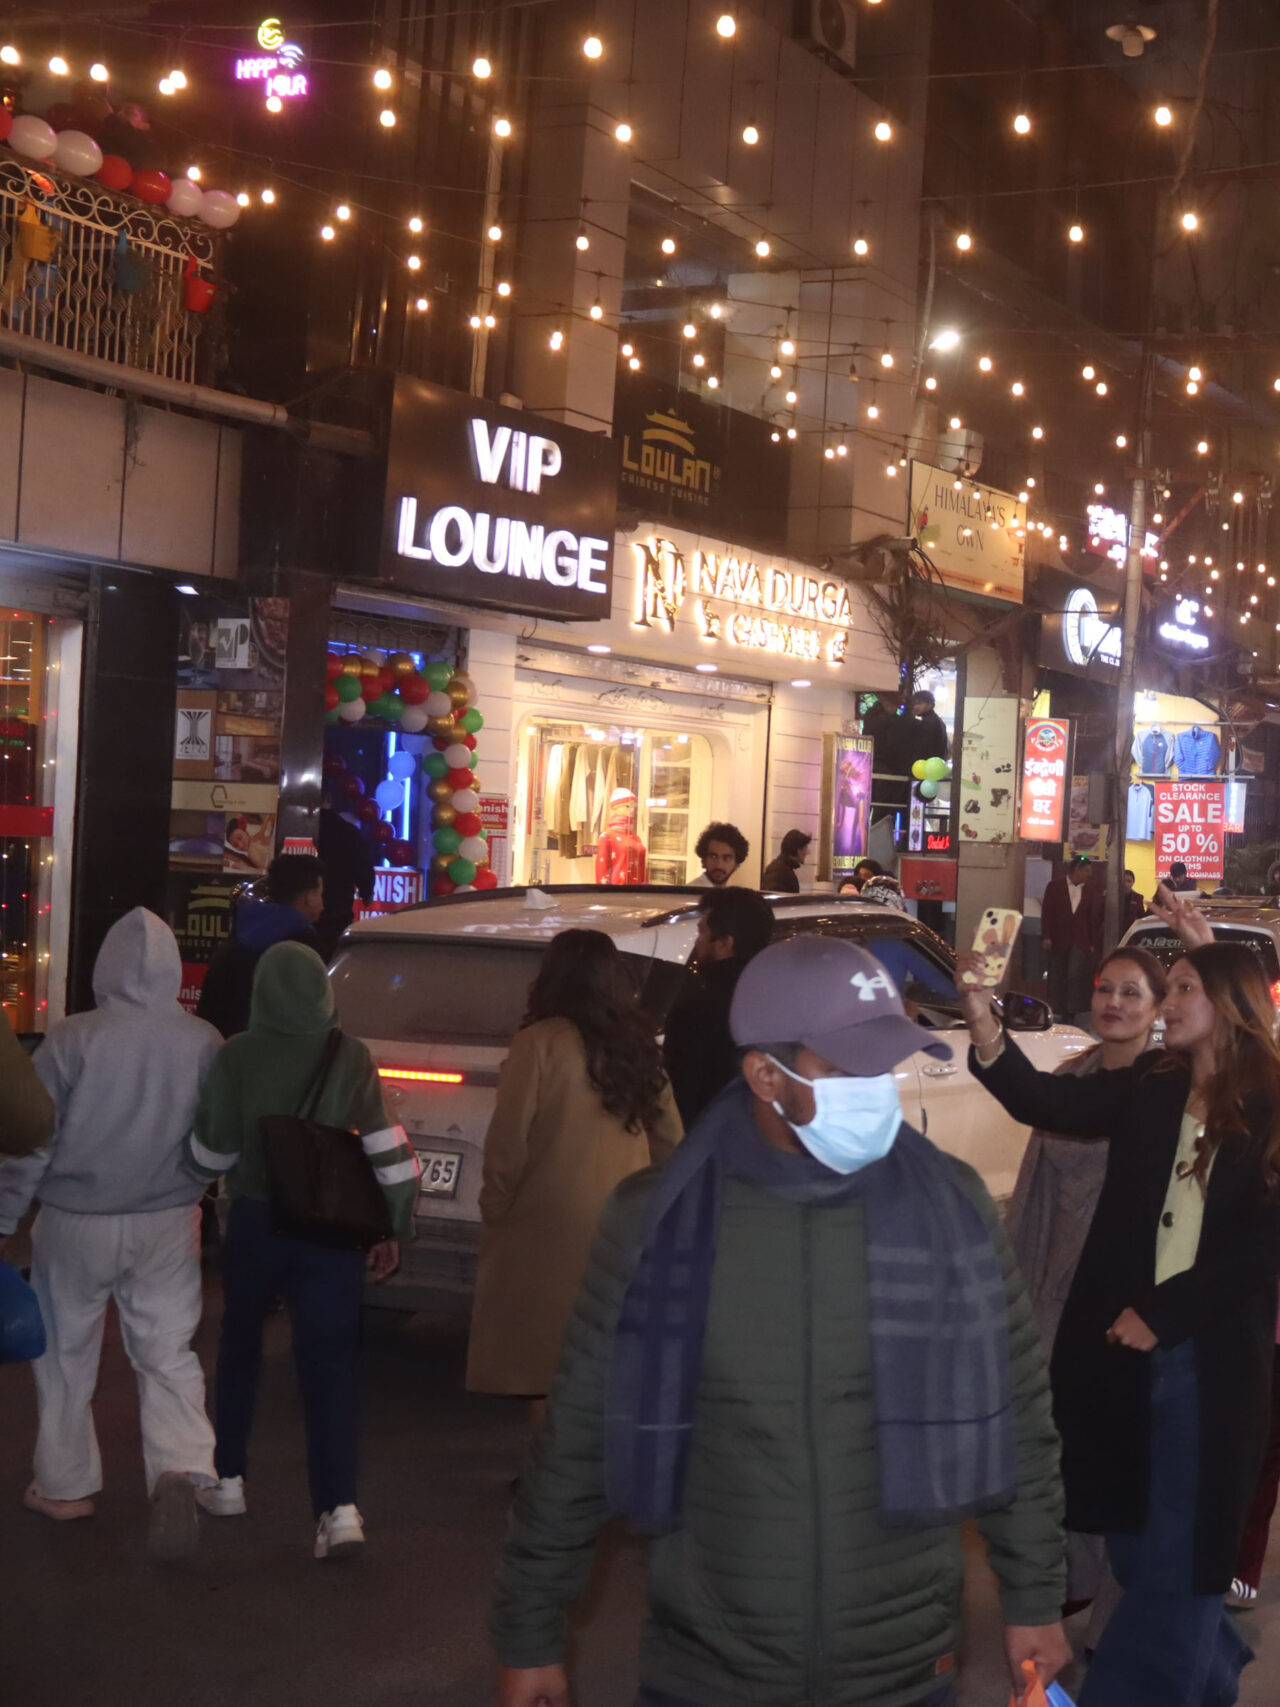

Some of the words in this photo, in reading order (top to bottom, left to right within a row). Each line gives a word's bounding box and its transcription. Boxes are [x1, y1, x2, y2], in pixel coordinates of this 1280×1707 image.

[472, 418, 562, 495] VIP
[623, 435, 711, 493] LOULAN
[622, 472, 664, 493] CHINESE
[671, 487, 709, 506] CUISINE
[397, 496, 610, 594] LOUNGE
[692, 551, 762, 605] NAVA
[765, 568, 853, 625] DURGA
[1159, 793, 1221, 801] CLEARANCE
[1172, 784, 1206, 792] STOCK
[1158, 803, 1222, 823] SALE
[1161, 833, 1190, 854] 50
[1196, 833, 1218, 853] %
[1174, 855, 1220, 863] CLOTHING
[420, 1158, 455, 1184] 765
